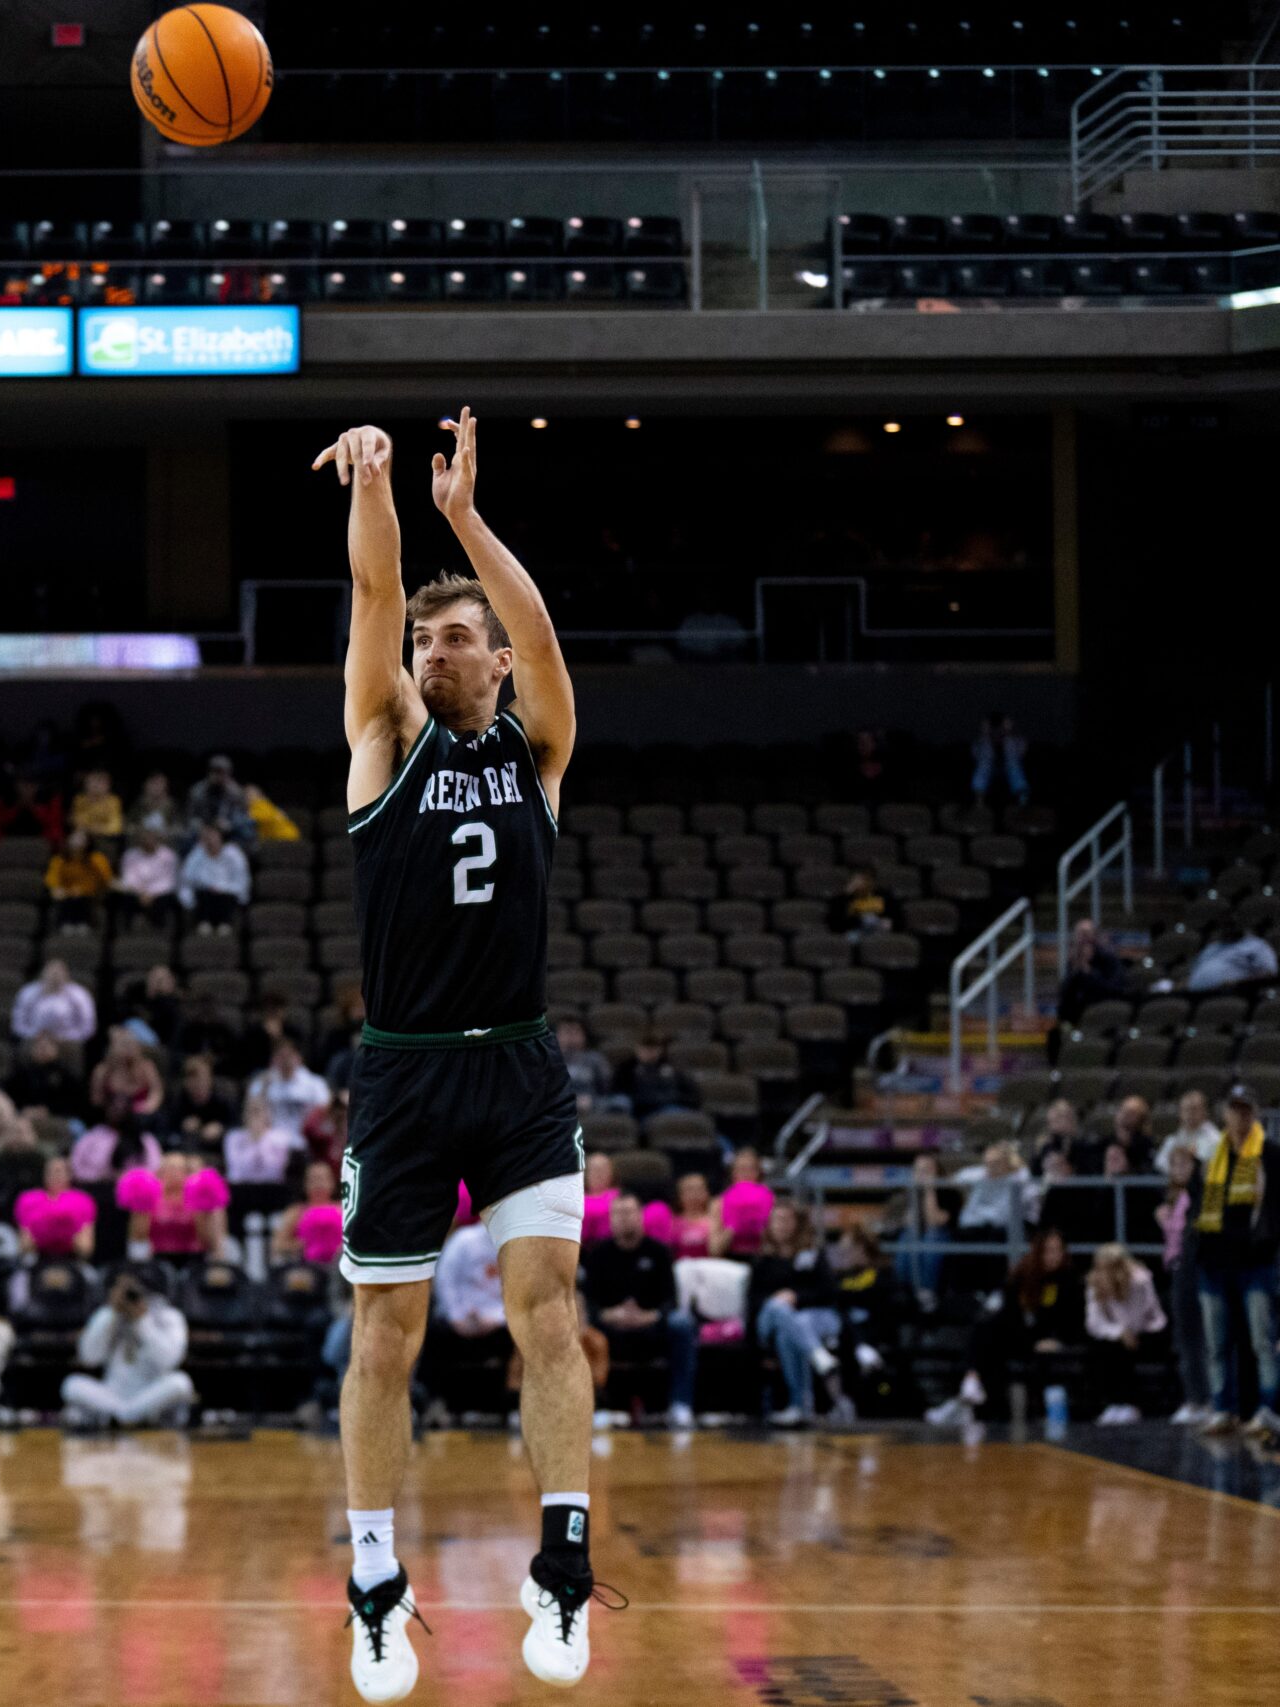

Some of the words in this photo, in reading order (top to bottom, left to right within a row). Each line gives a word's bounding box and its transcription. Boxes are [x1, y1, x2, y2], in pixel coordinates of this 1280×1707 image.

[172, 325, 294, 352] Elizabeth
[418, 769, 482, 814] REEN
[451, 821, 497, 905] 2
